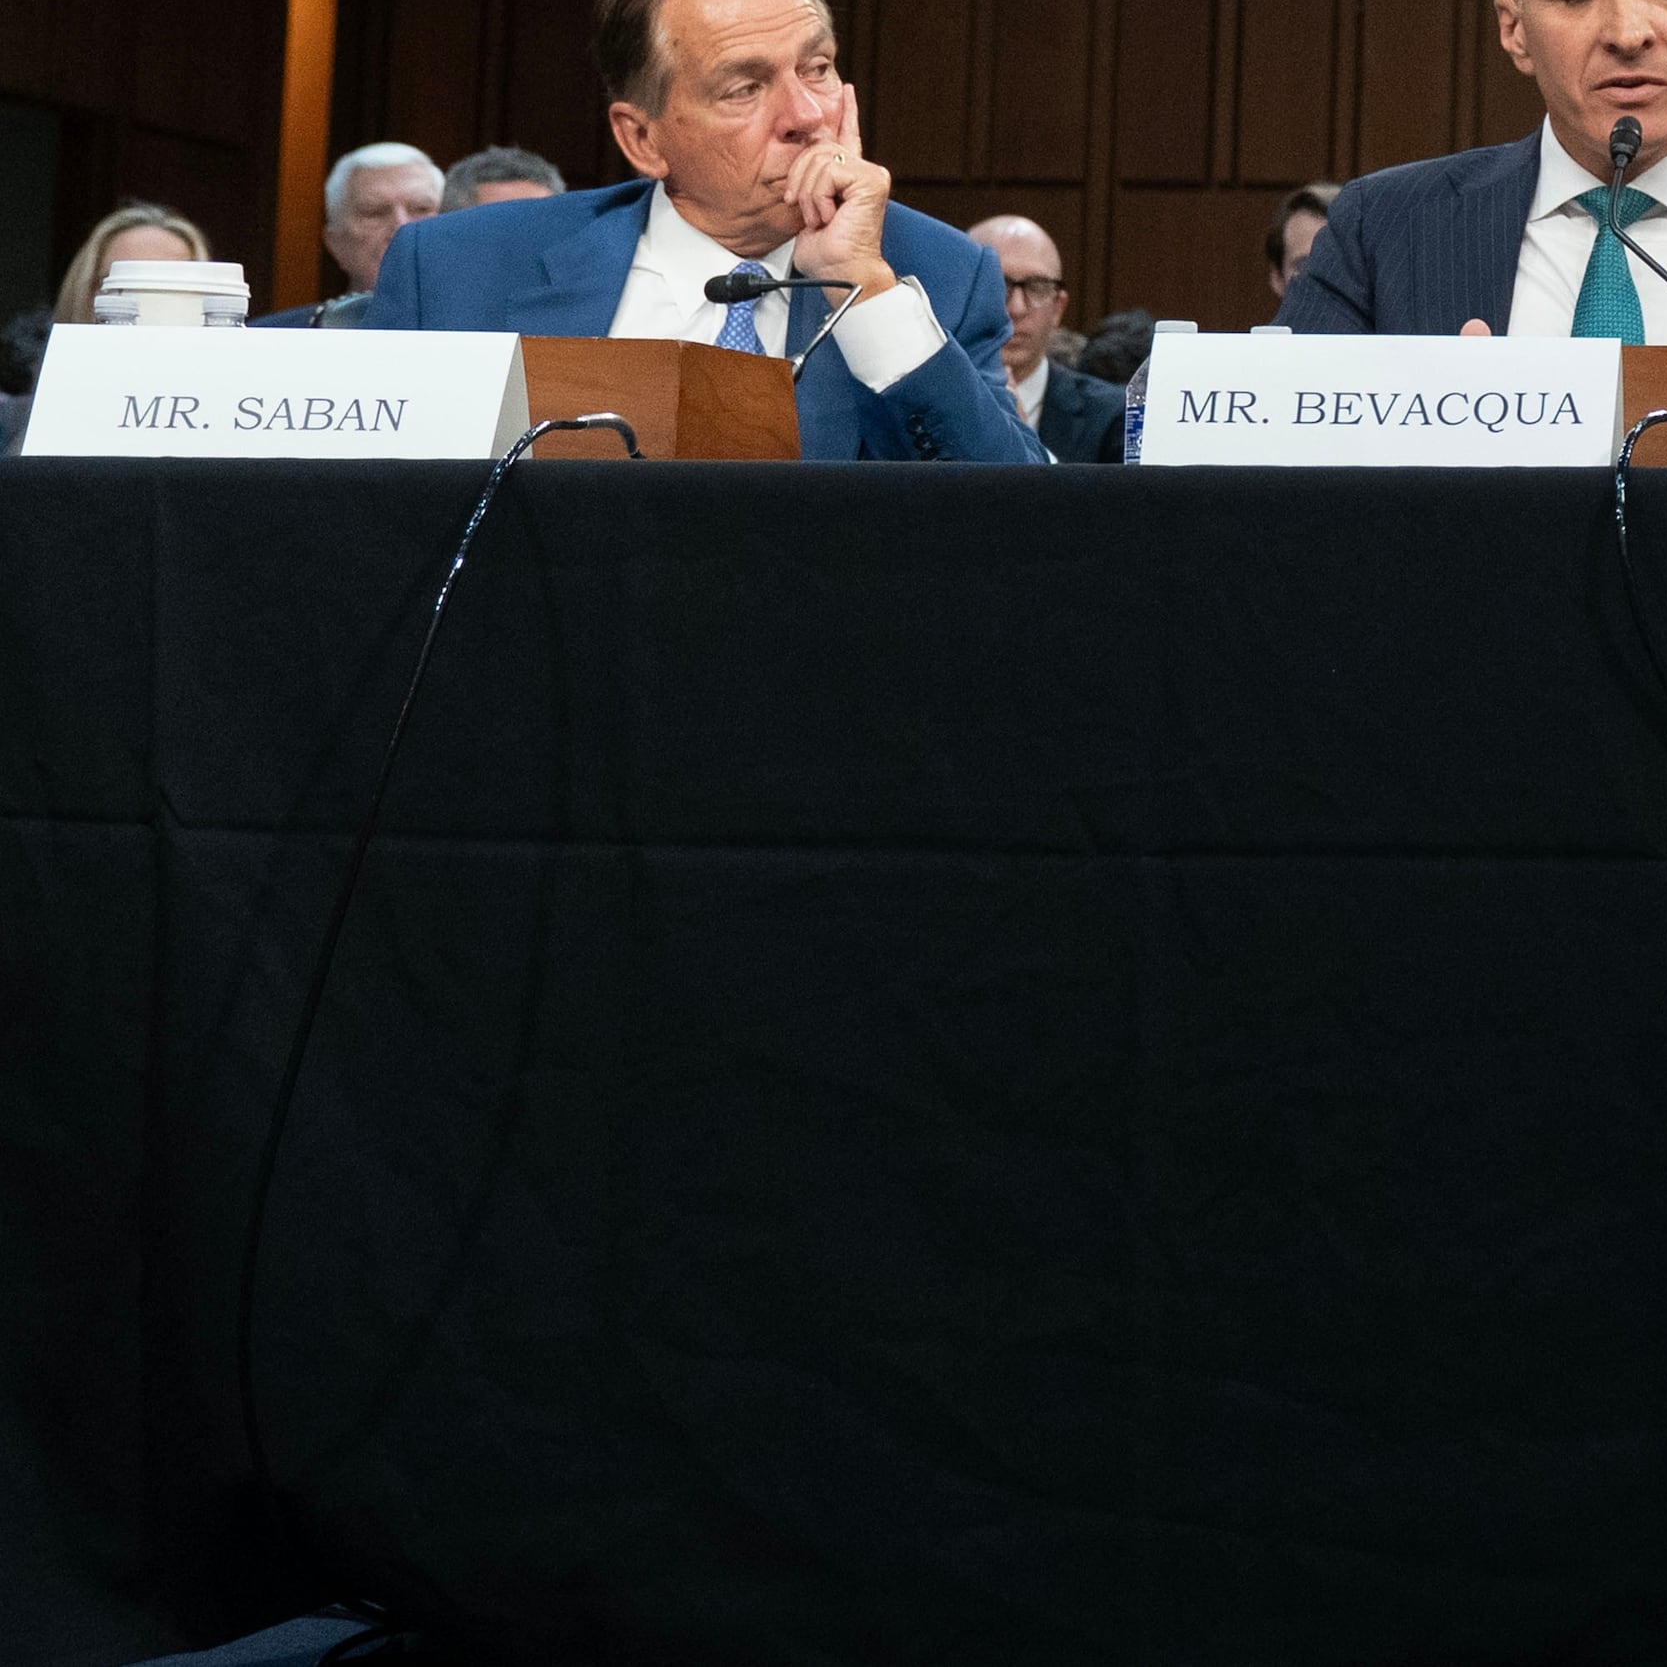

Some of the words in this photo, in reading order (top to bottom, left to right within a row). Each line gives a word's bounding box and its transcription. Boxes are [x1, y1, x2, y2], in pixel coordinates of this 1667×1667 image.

[117, 395, 210, 430] MR.
[234, 396, 409, 432] SABAN
[1177, 389, 1269, 425] MR.
[1291, 391, 1583, 434] BEVACQUA
